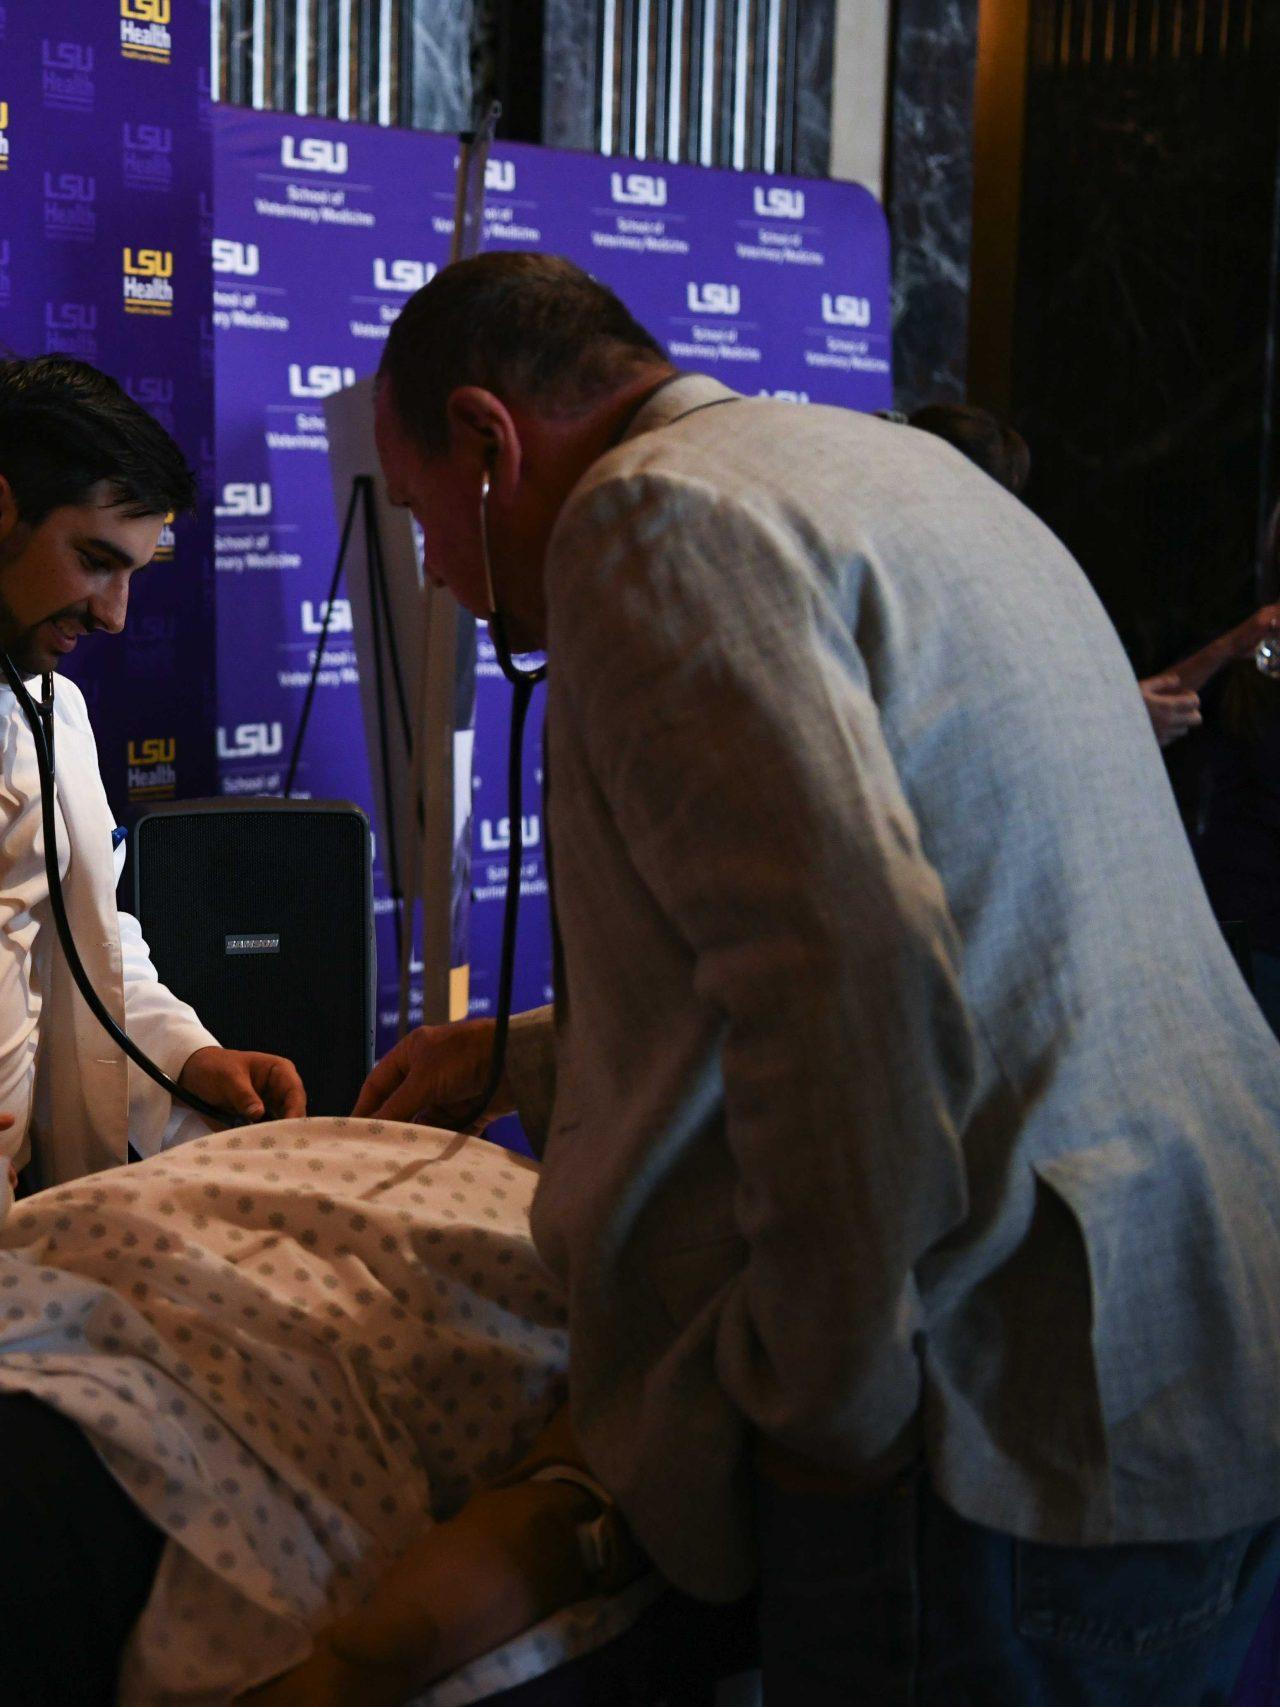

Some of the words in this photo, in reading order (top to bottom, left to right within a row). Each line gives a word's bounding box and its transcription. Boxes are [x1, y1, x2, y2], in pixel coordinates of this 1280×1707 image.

[121, 19, 172, 49] Health
[281, 135, 348, 174] LSU
[611, 171, 667, 207] LSU
[753, 185, 804, 219] LSU
[123, 247, 173, 278] LSU
[211, 238, 259, 276] SU
[124, 275, 173, 300] Health
[687, 281, 740, 315] LSU
[822, 293, 870, 328] LSU
[128, 737, 176, 766] LSU
[217, 722, 282, 758] LSU
[128, 764, 176, 788] Health
